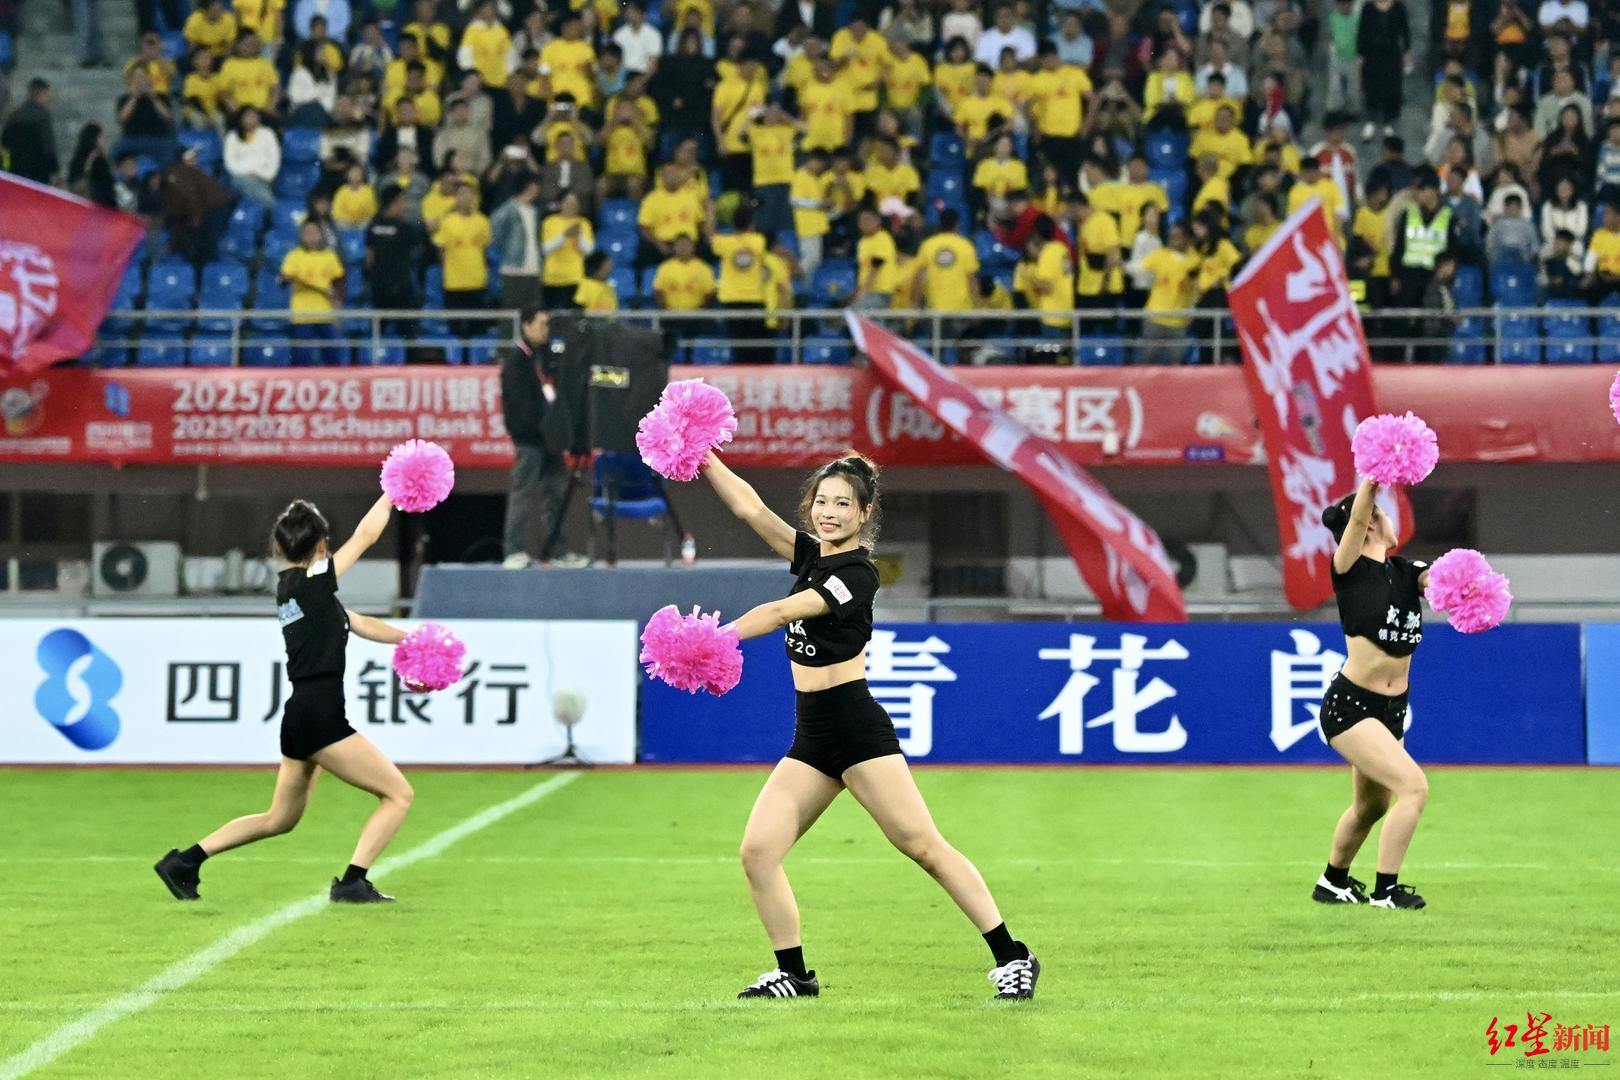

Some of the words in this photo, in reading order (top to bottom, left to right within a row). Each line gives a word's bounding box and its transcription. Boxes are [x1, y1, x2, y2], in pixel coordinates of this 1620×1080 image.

[172, 378, 362, 413] 2025/2026
[172, 414, 305, 440] 2025/2026
[310, 414, 413, 438] Sichuan
[418, 414, 482, 437] Bank
[167, 660, 530, 725] 四银行
